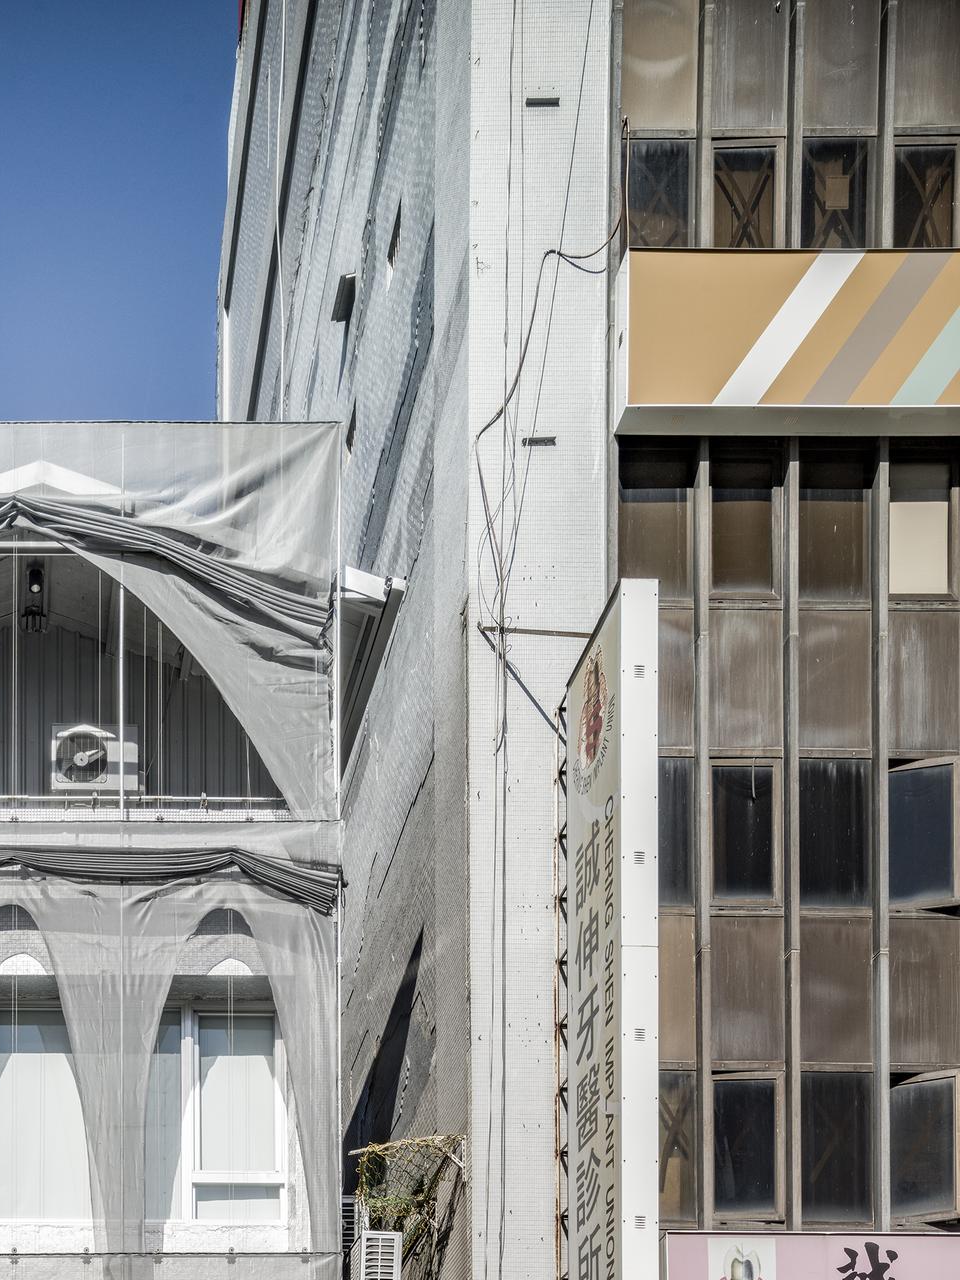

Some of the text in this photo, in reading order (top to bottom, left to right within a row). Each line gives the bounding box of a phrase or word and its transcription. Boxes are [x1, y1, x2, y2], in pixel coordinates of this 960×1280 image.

[604, 795, 614, 929] CHERNG
[604, 945, 614, 1027] SHEN
[604, 1037, 615, 1169] IMPLANT
